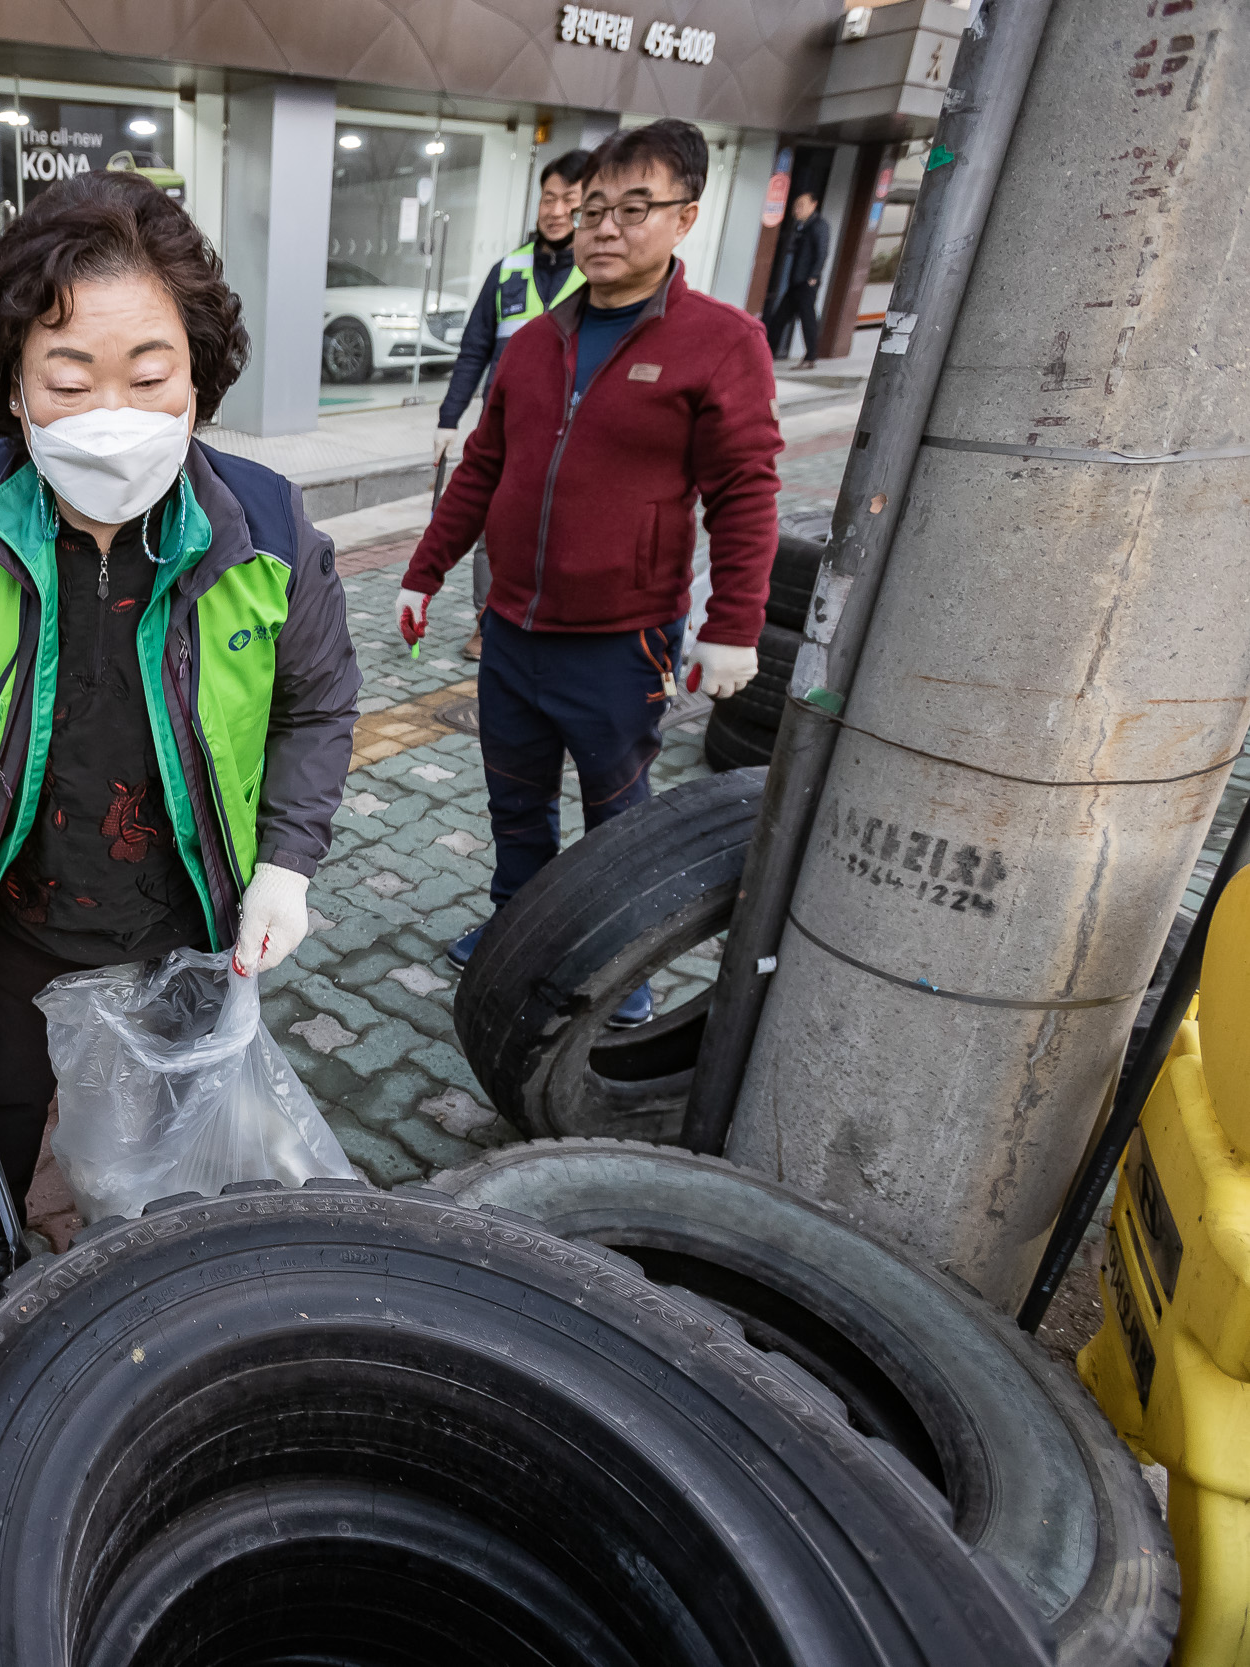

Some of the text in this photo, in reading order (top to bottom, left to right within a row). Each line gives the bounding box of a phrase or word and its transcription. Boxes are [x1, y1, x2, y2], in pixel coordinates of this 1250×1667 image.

[561, 4, 716, 65] 광진대리점 456-8008
[22, 127, 103, 147] The all-new
[22, 151, 91, 181] KONA
[7, 1216, 189, 1324] 8.15-15
[436, 1210, 698, 1331] POWER
[550, 1311, 584, 1333] NOT
